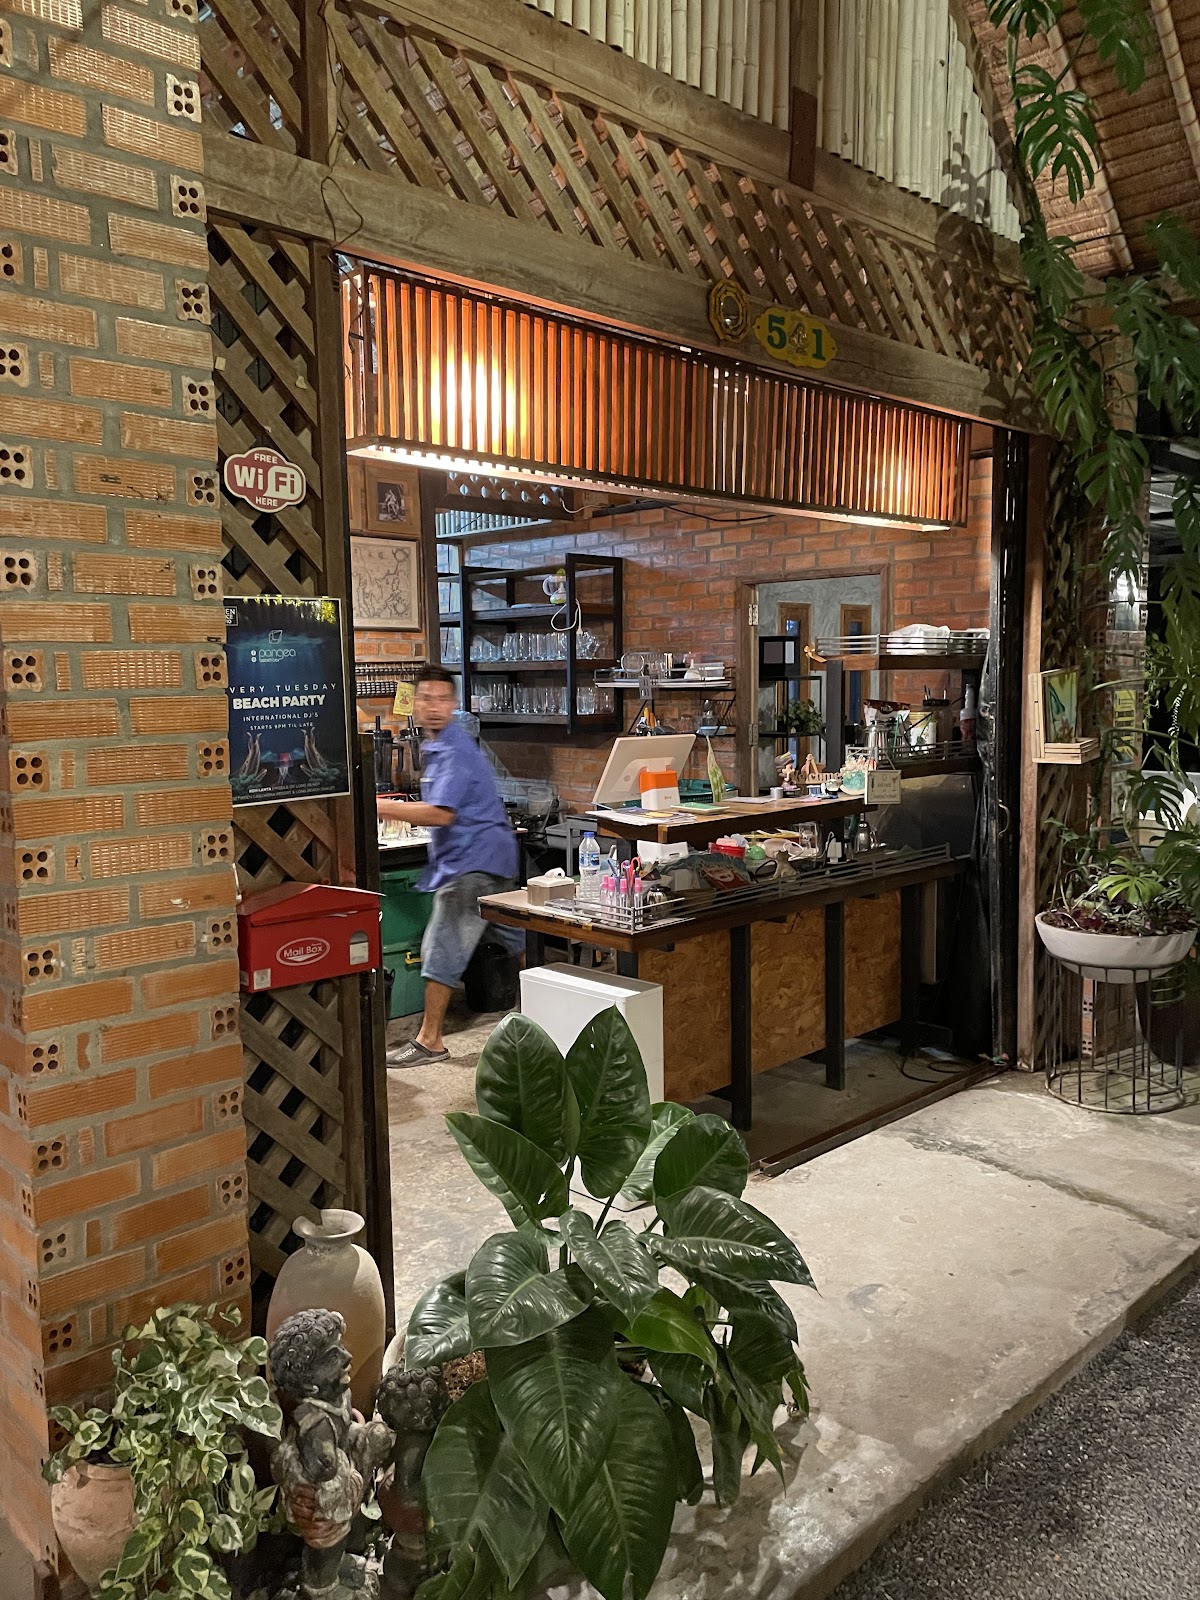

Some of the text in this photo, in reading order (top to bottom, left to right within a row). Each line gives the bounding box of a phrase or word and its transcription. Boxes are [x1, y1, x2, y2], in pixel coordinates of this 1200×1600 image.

[254, 453, 278, 464] FREE
[255, 496, 278, 507] HERE
[259, 648, 296, 660] pangea
[229, 683, 336, 694] VERY TUESDAY
[232, 694, 326, 710] BEACH PARTY
[243, 711, 319, 722] INTERNATIONAL DJ'S
[283, 944, 323, 958] Mail Box
